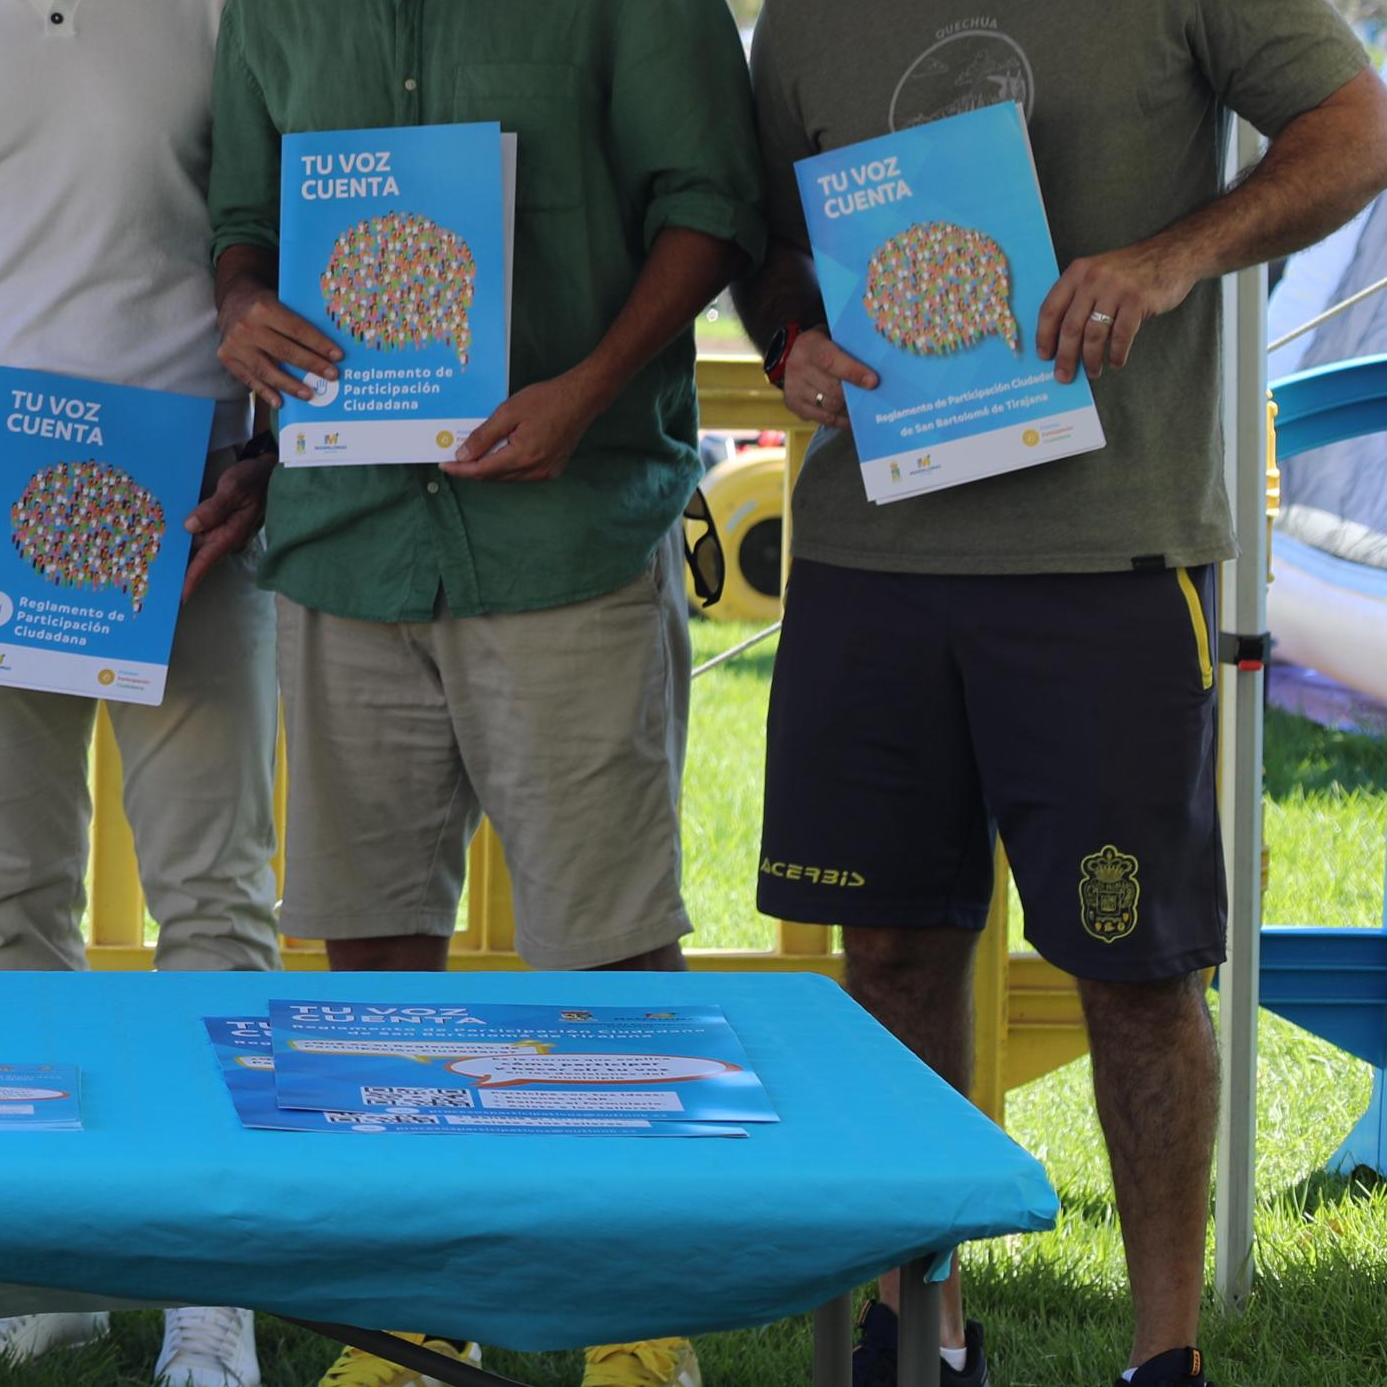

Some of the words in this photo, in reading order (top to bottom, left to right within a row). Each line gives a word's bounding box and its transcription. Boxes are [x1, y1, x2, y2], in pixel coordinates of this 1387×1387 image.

[935, 16, 998, 40] QUECHUA
[301, 154, 333, 175] TU
[339, 152, 391, 173] VOZ
[301, 176, 400, 200] CUENTA
[817, 171, 848, 196] TU
[851, 156, 901, 186] VOZ
[825, 179, 913, 219] CUENTA
[345, 368, 431, 382] Reglamento
[436, 366, 454, 378] de
[344, 382, 440, 397] Participación
[11, 390, 44, 412] TU
[49, 395, 102, 422] VOZ
[344, 399, 419, 411] Ciudadana
[876, 401, 933, 423] Reglamento
[934, 399, 947, 408] de
[948, 381, 1010, 405] Participación
[900, 427, 913, 437] de
[915, 422, 934, 434] San
[936, 408, 989, 427] Bartolomé
[991, 404, 1004, 414] de
[1005, 392, 1048, 410] Tirajana
[6, 413, 104, 446] CUENTA
[19, 596, 103, 620] Reglamento
[108, 610, 125, 622] de
[17, 611, 110, 635] Participación
[14, 625, 87, 646] Ciudadana
[290, 1005, 352, 1014] TU
[367, 1007, 469, 1016] VOZ
[292, 1014, 487, 1025] CUENTA
